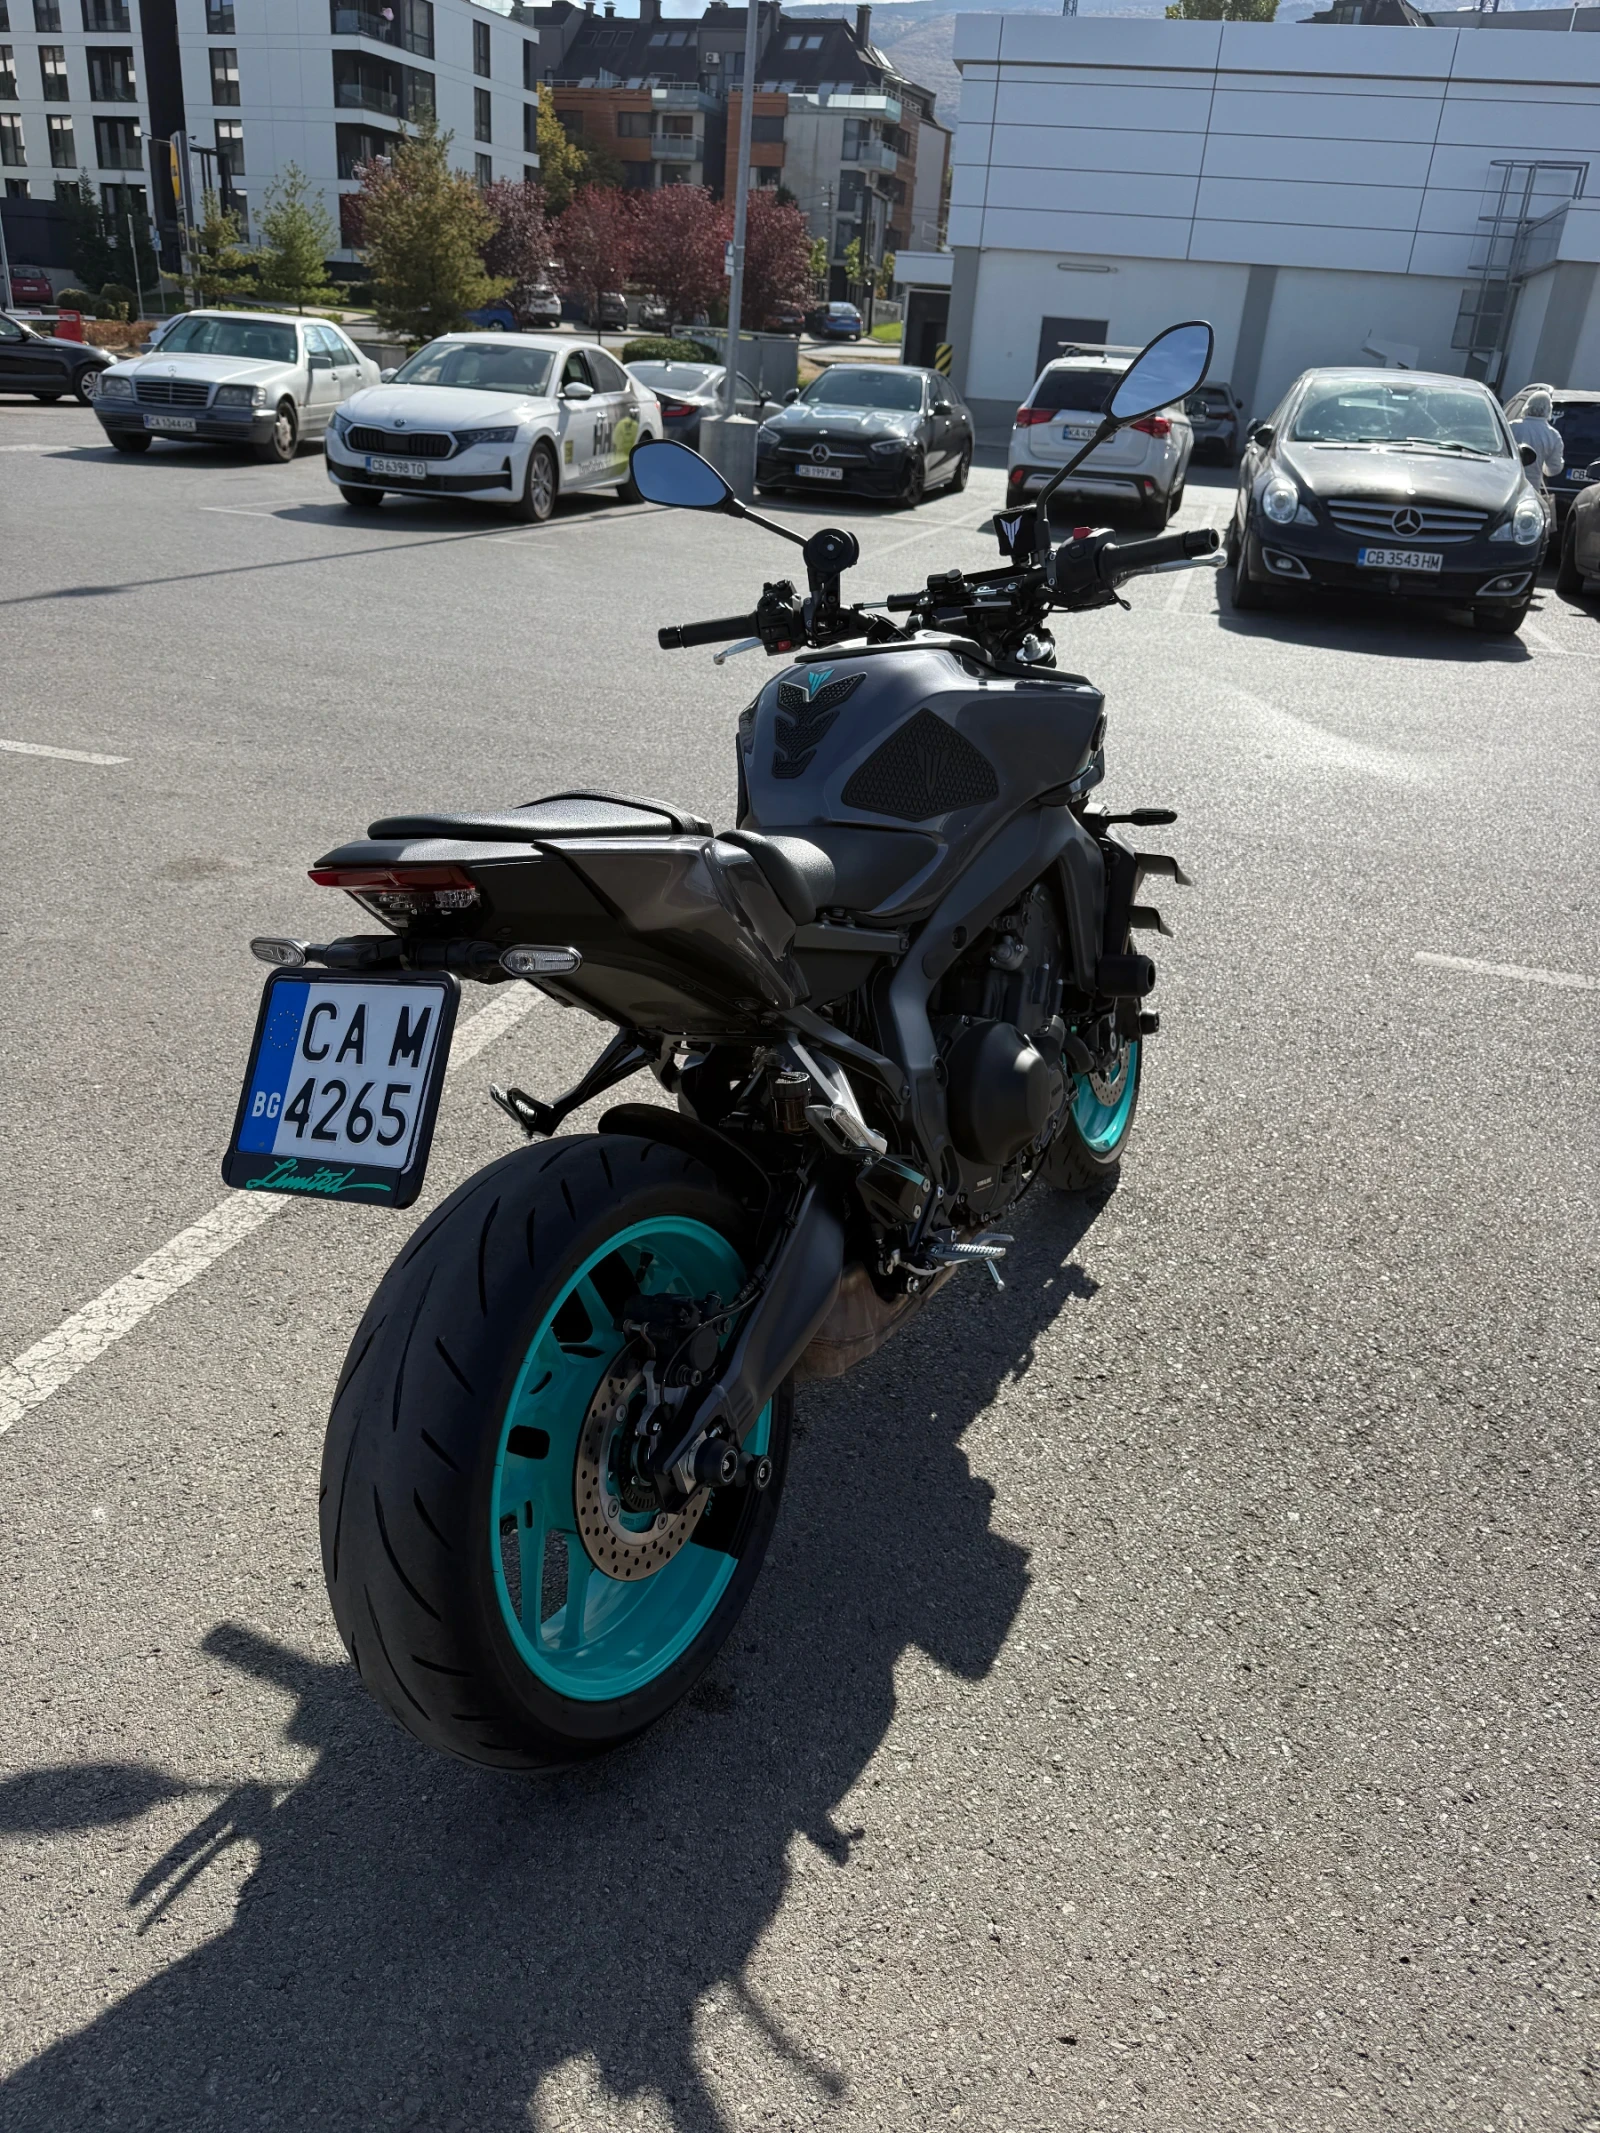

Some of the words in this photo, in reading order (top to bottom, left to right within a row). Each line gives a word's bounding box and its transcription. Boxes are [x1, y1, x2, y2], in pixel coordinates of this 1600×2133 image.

[372, 459, 385, 471] CB
[385, 461, 410, 474] 6398
[410, 463, 424, 475] TO
[1572, 469, 1585, 480] CB
[1366, 550, 1385, 564] CB
[1387, 551, 1420, 567] 3543
[1420, 554, 1441, 569] HM
[301, 1001, 366, 1065] CA
[388, 1005, 432, 1068] M
[251, 1090, 282, 1119] BG
[283, 1077, 412, 1147] 4265
[245, 1158, 392, 1194] Limited
